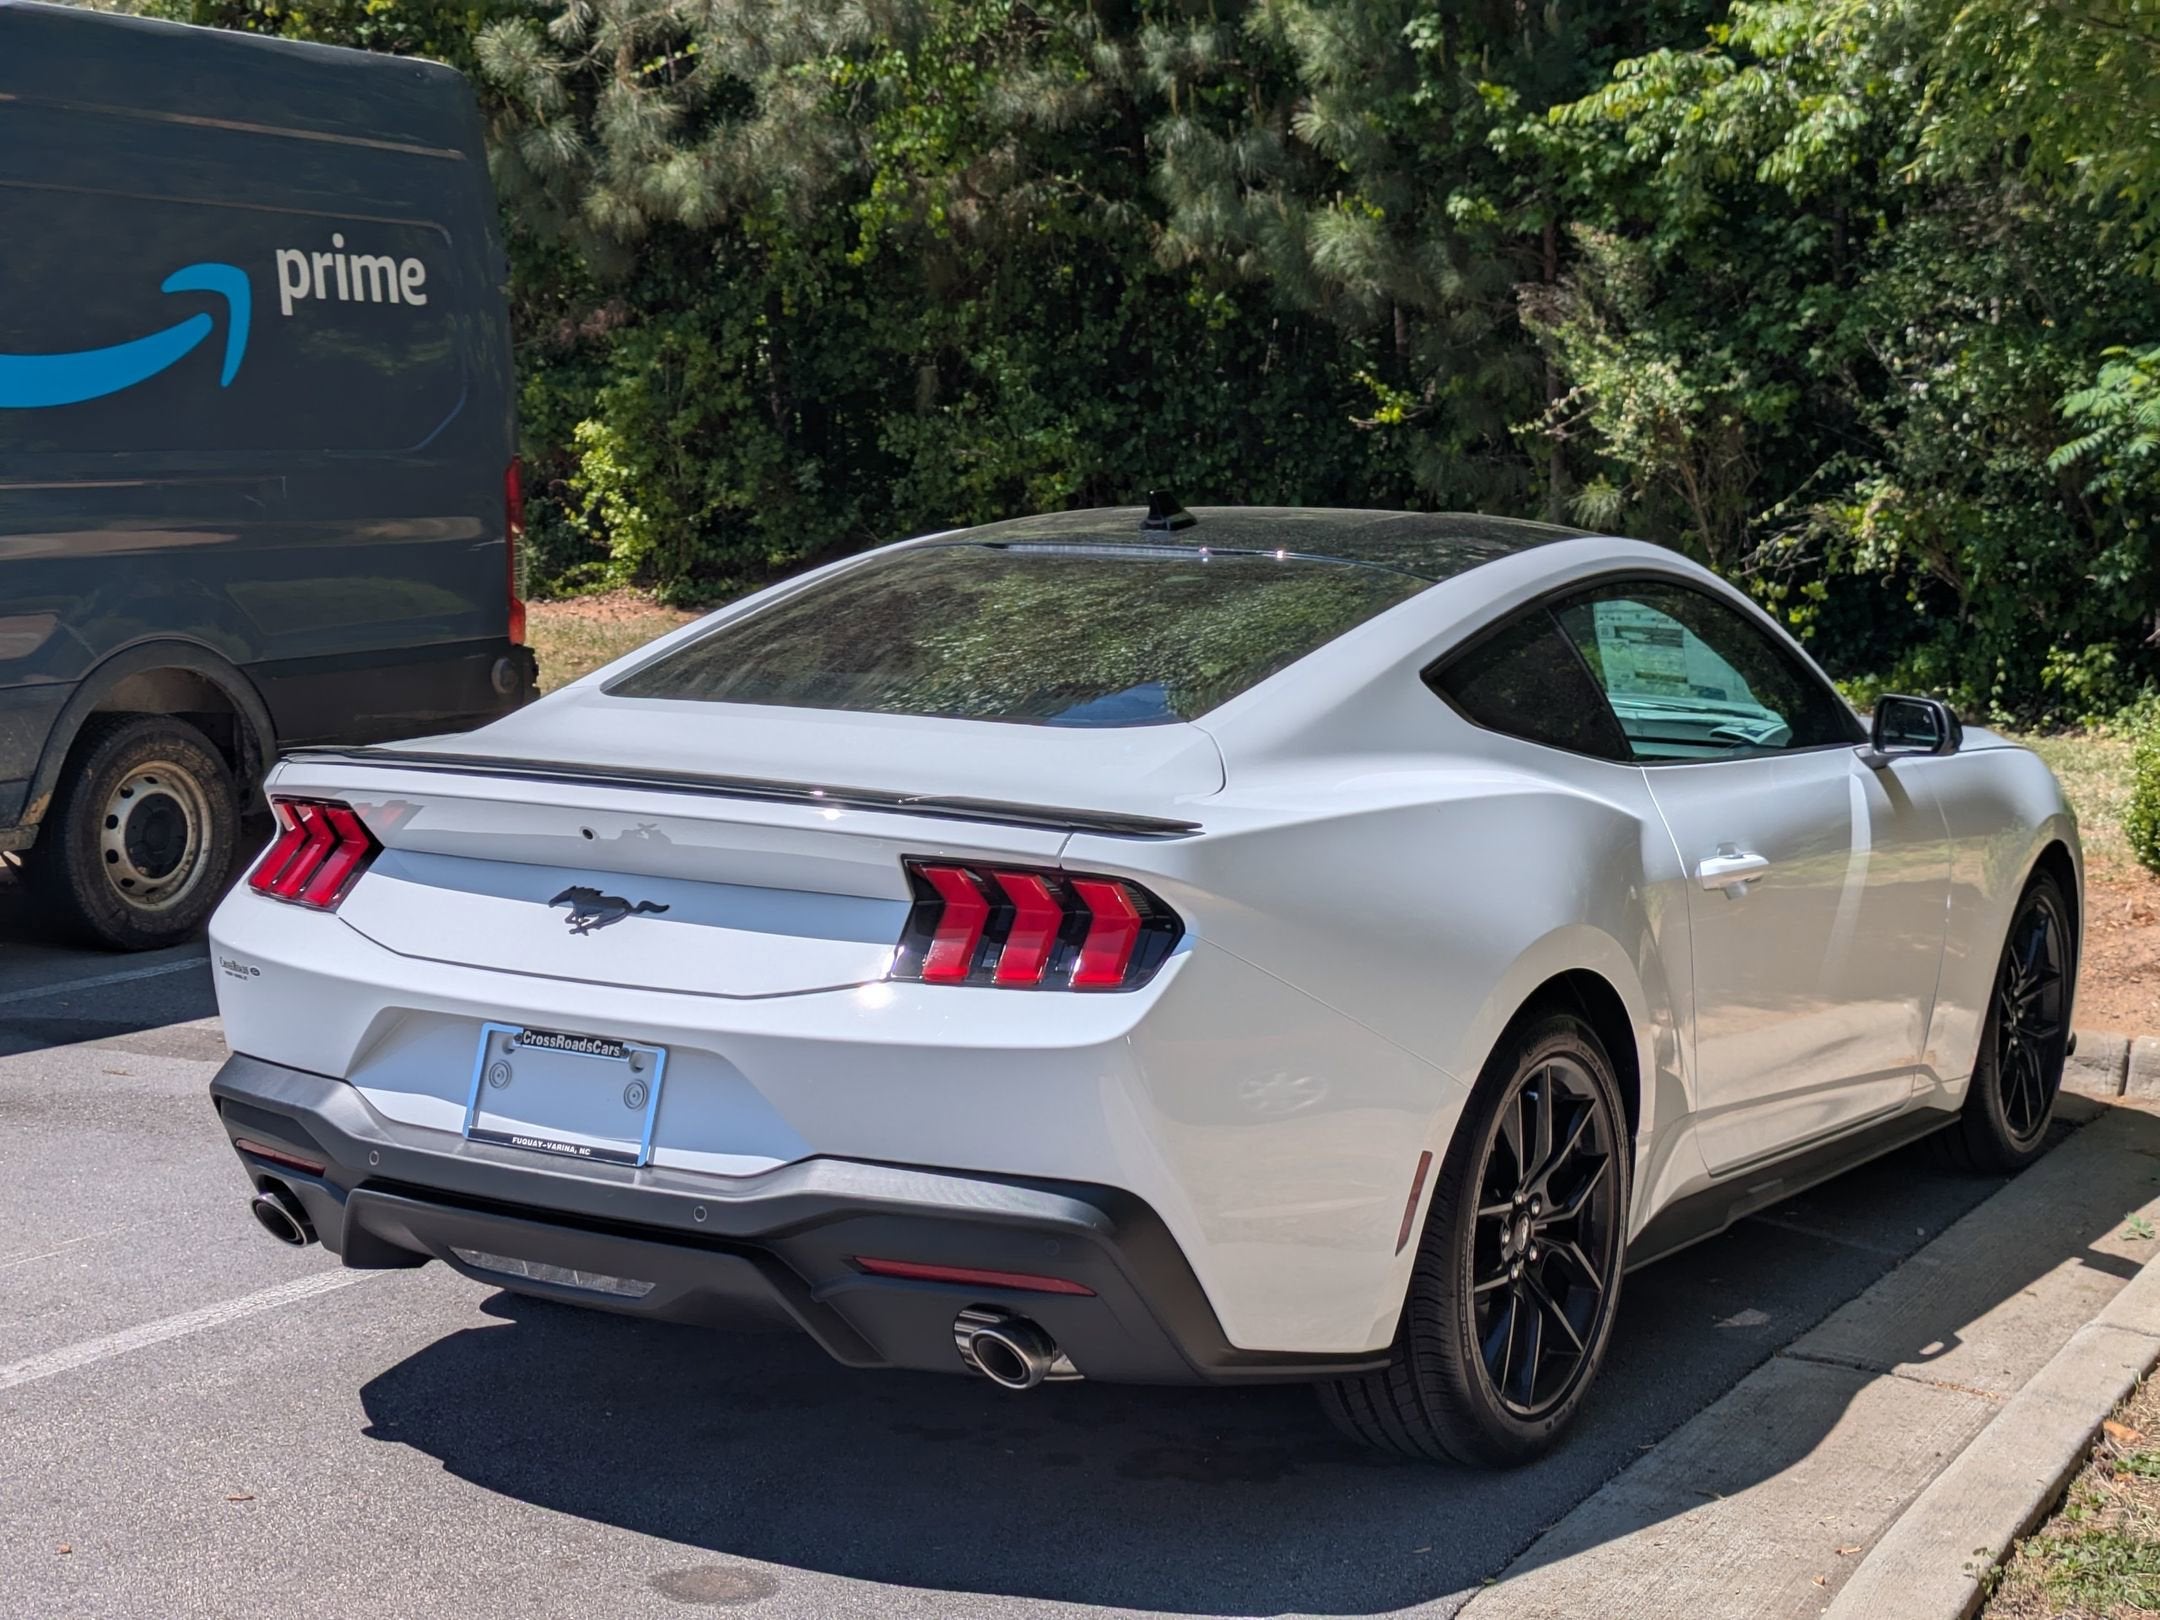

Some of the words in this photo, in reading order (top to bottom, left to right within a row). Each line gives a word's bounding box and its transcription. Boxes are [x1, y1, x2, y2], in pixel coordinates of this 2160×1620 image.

[276, 233, 427, 316] prime
[523, 1031, 620, 1056] CrossRoadsCars
[512, 1137, 577, 1154] FUQUAY-VARINA,
